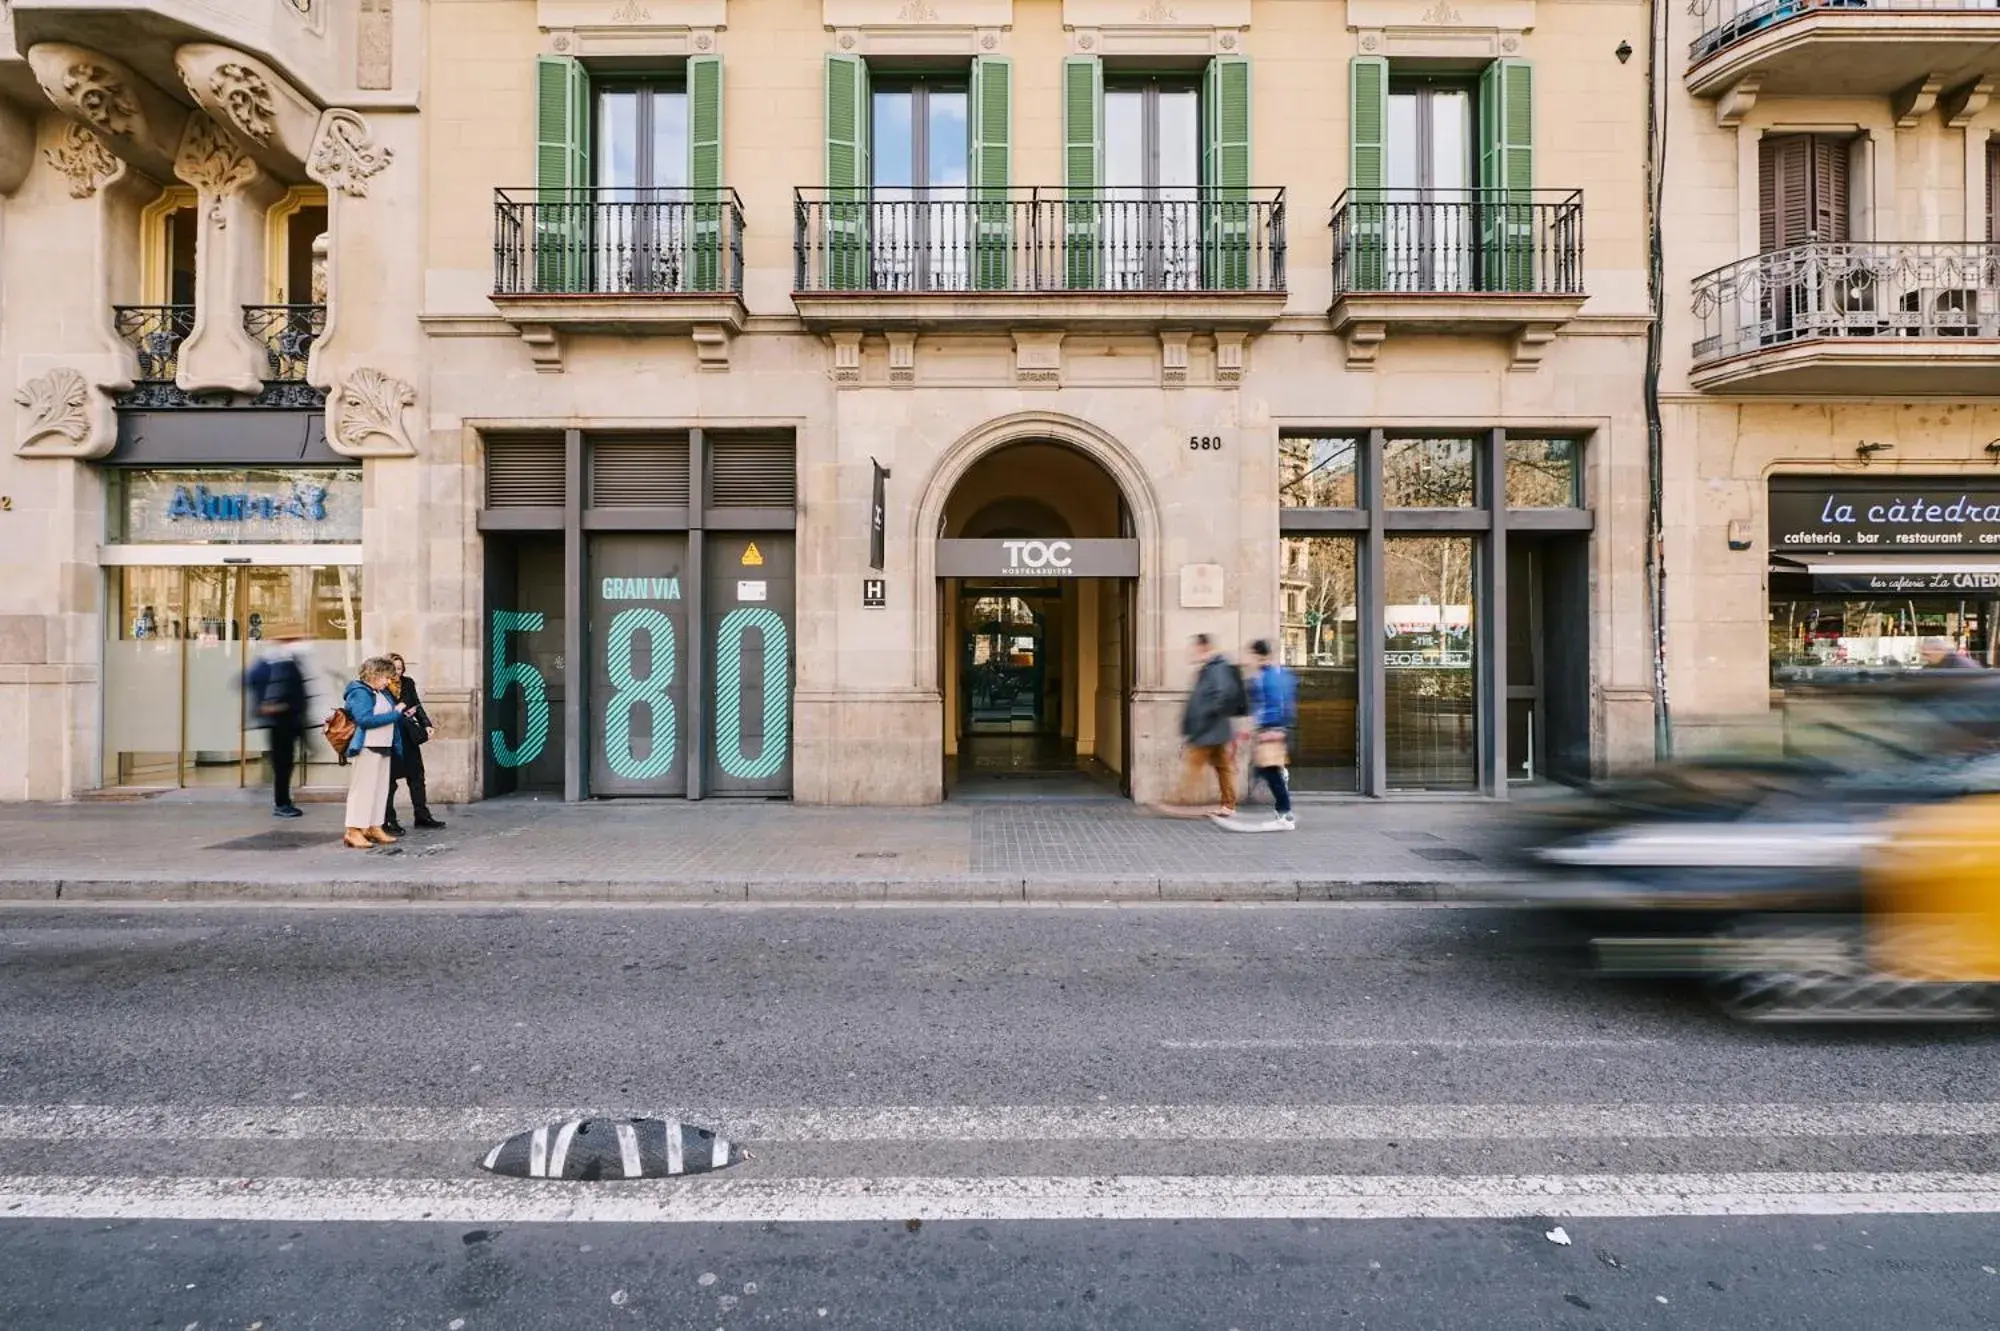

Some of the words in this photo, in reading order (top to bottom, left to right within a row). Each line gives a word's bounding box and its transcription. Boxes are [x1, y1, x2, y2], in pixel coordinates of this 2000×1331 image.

[1190, 436, 1221, 450] 580
[1784, 531, 1841, 544] cafeteria
[1857, 531, 1880, 544] bar
[1896, 531, 1963, 544] restaurant
[1002, 541, 1072, 567] TOC
[602, 577, 648, 599] GRAN
[651, 577, 681, 599] VIA
[868, 581, 881, 598] H
[491, 607, 788, 780] 580
